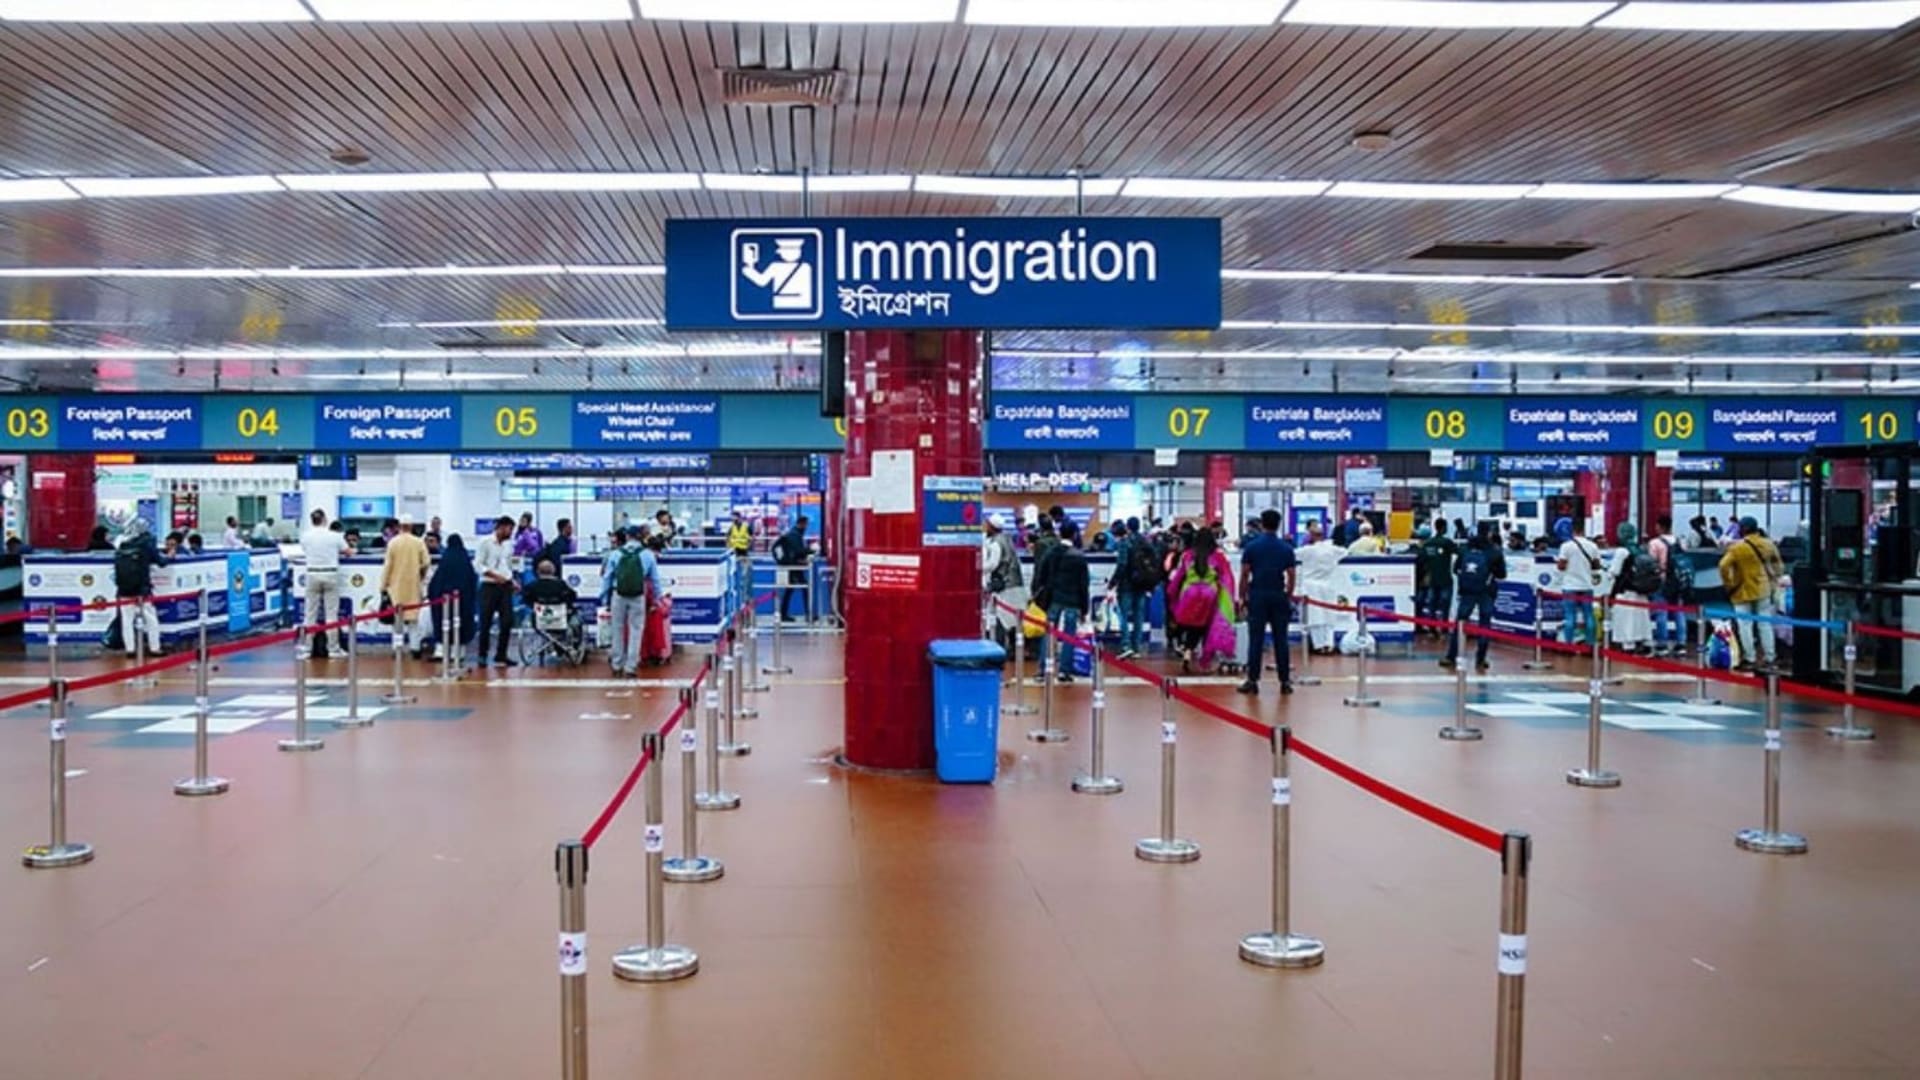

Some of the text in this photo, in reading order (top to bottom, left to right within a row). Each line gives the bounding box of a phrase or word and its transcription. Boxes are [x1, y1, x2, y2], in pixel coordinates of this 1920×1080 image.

[836, 227, 1157, 294] Immigration
[837, 285, 951, 317] ইমিগ্রেশন
[66, 407, 192, 423] Foreign Passport
[323, 405, 452, 421] Foreign Passport
[577, 402, 716, 415] Special Need Assistance/
[995, 405, 1130, 421] Expatriate Bangladeshi
[1252, 407, 1382, 423] Expatriate Bangladeshi
[1509, 409, 1638, 425] Expatriate Bangladeshi
[1713, 409, 1837, 425] Bangladeshi Passport
[7, 409, 49, 437] 03
[238, 408, 279, 437] 04
[495, 407, 538, 437] 05
[607, 415, 676, 427] Wheel Chair
[1169, 407, 1210, 437] 07
[1426, 410, 1466, 438] 08
[1654, 411, 1694, 439] 09
[1860, 412, 1898, 439] 10
[1000, 473, 1089, 486] HELP DESK
